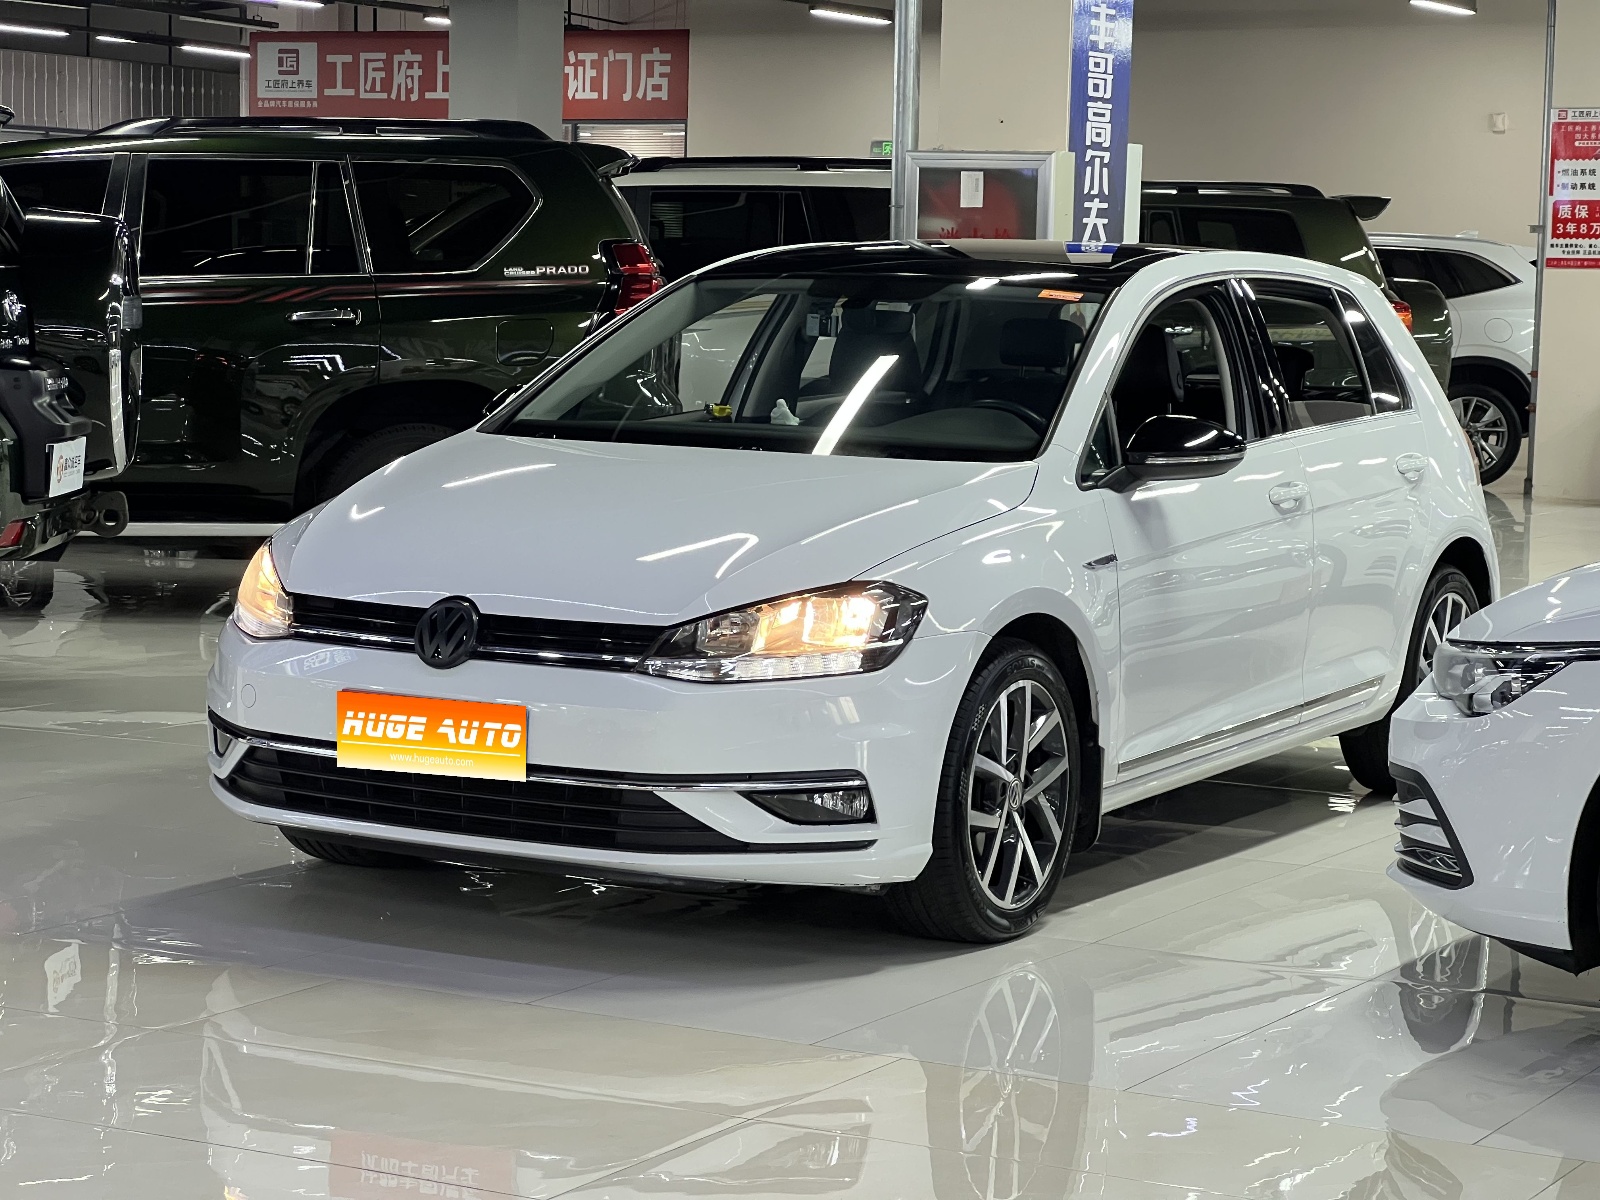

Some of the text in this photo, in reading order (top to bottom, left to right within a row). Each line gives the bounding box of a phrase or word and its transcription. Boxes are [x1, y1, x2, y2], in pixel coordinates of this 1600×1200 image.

[323, 47, 672, 102] 工匠府上 证门店
[264, 79, 313, 89] 工匠府上养车
[1571, 110, 1600, 118] 工匠府上
[1082, 3, 1116, 244] 丰哥高尔夫
[1561, 168, 1597, 177] 燃油系统
[1560, 182, 1597, 191] 制动系统
[1557, 204, 1589, 219] 质保
[1556, 222, 1600, 235] 3年8万
[535, 264, 590, 275] PRADO
